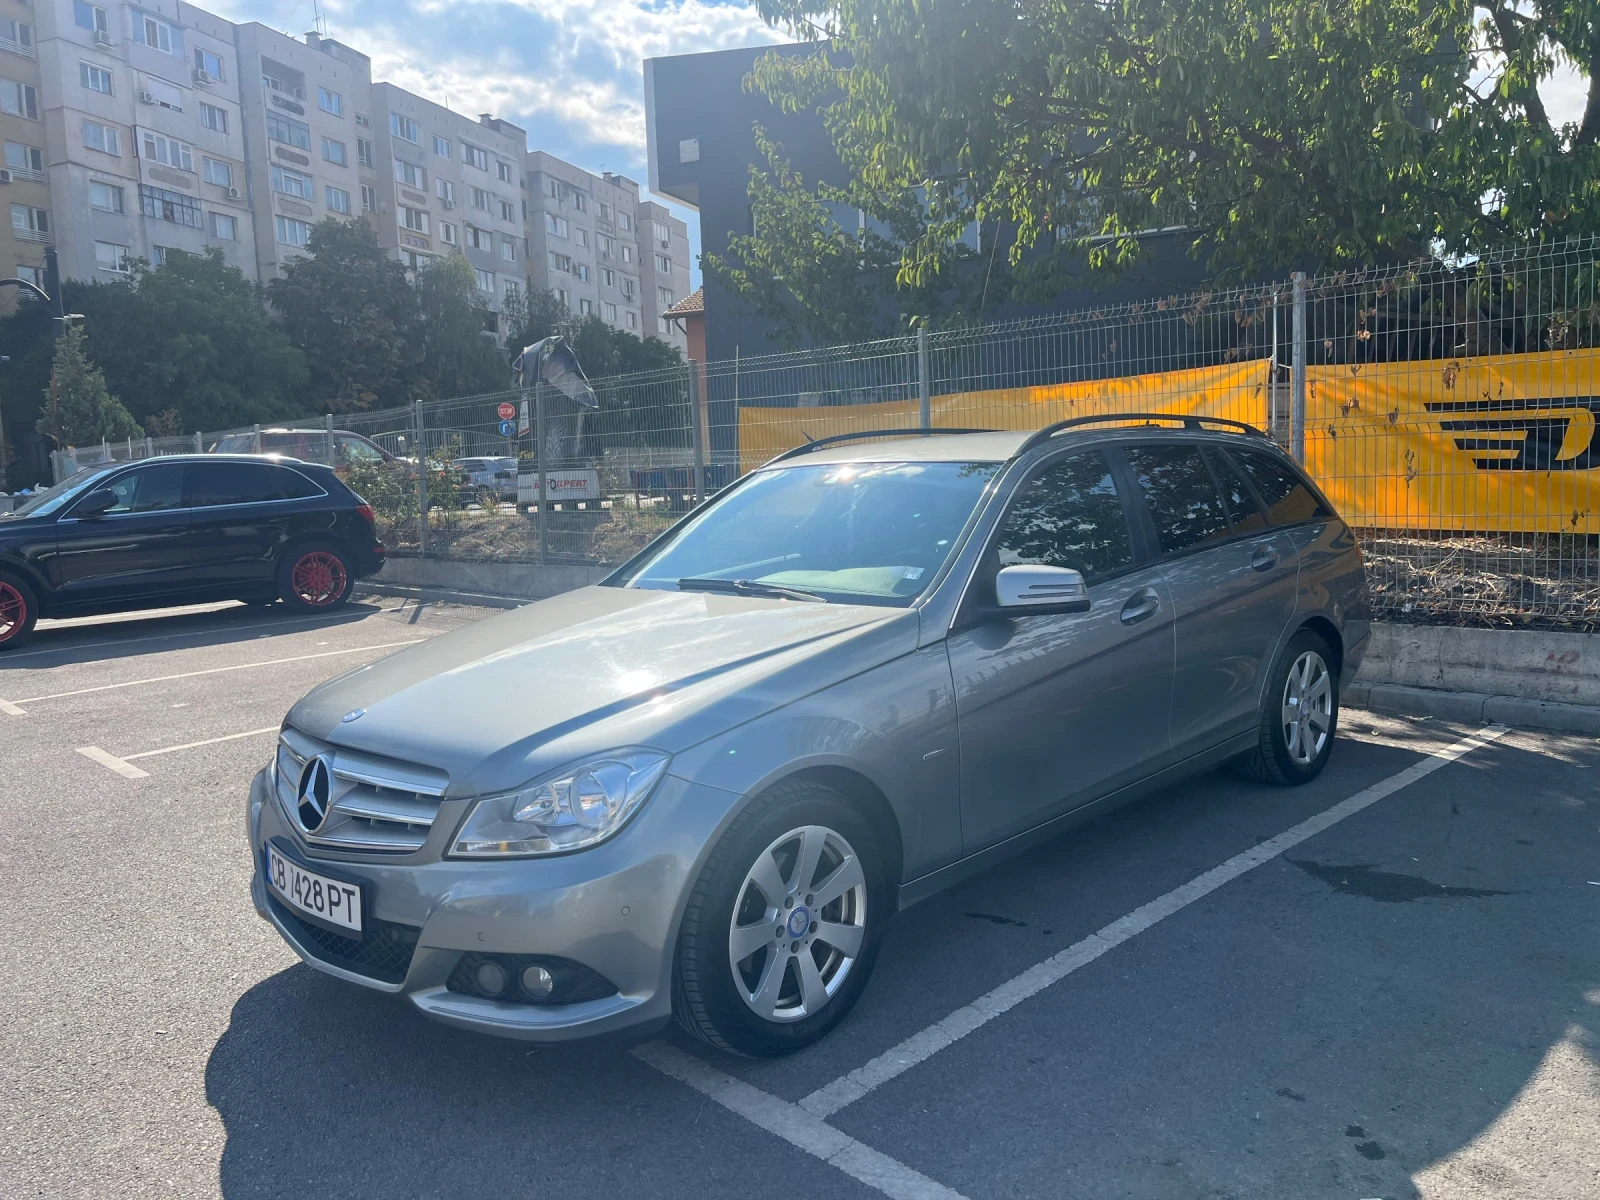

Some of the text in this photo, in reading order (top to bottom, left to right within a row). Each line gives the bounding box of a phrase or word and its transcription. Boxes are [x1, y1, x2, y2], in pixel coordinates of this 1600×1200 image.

[271, 853, 356, 923] CB 1428 PT
